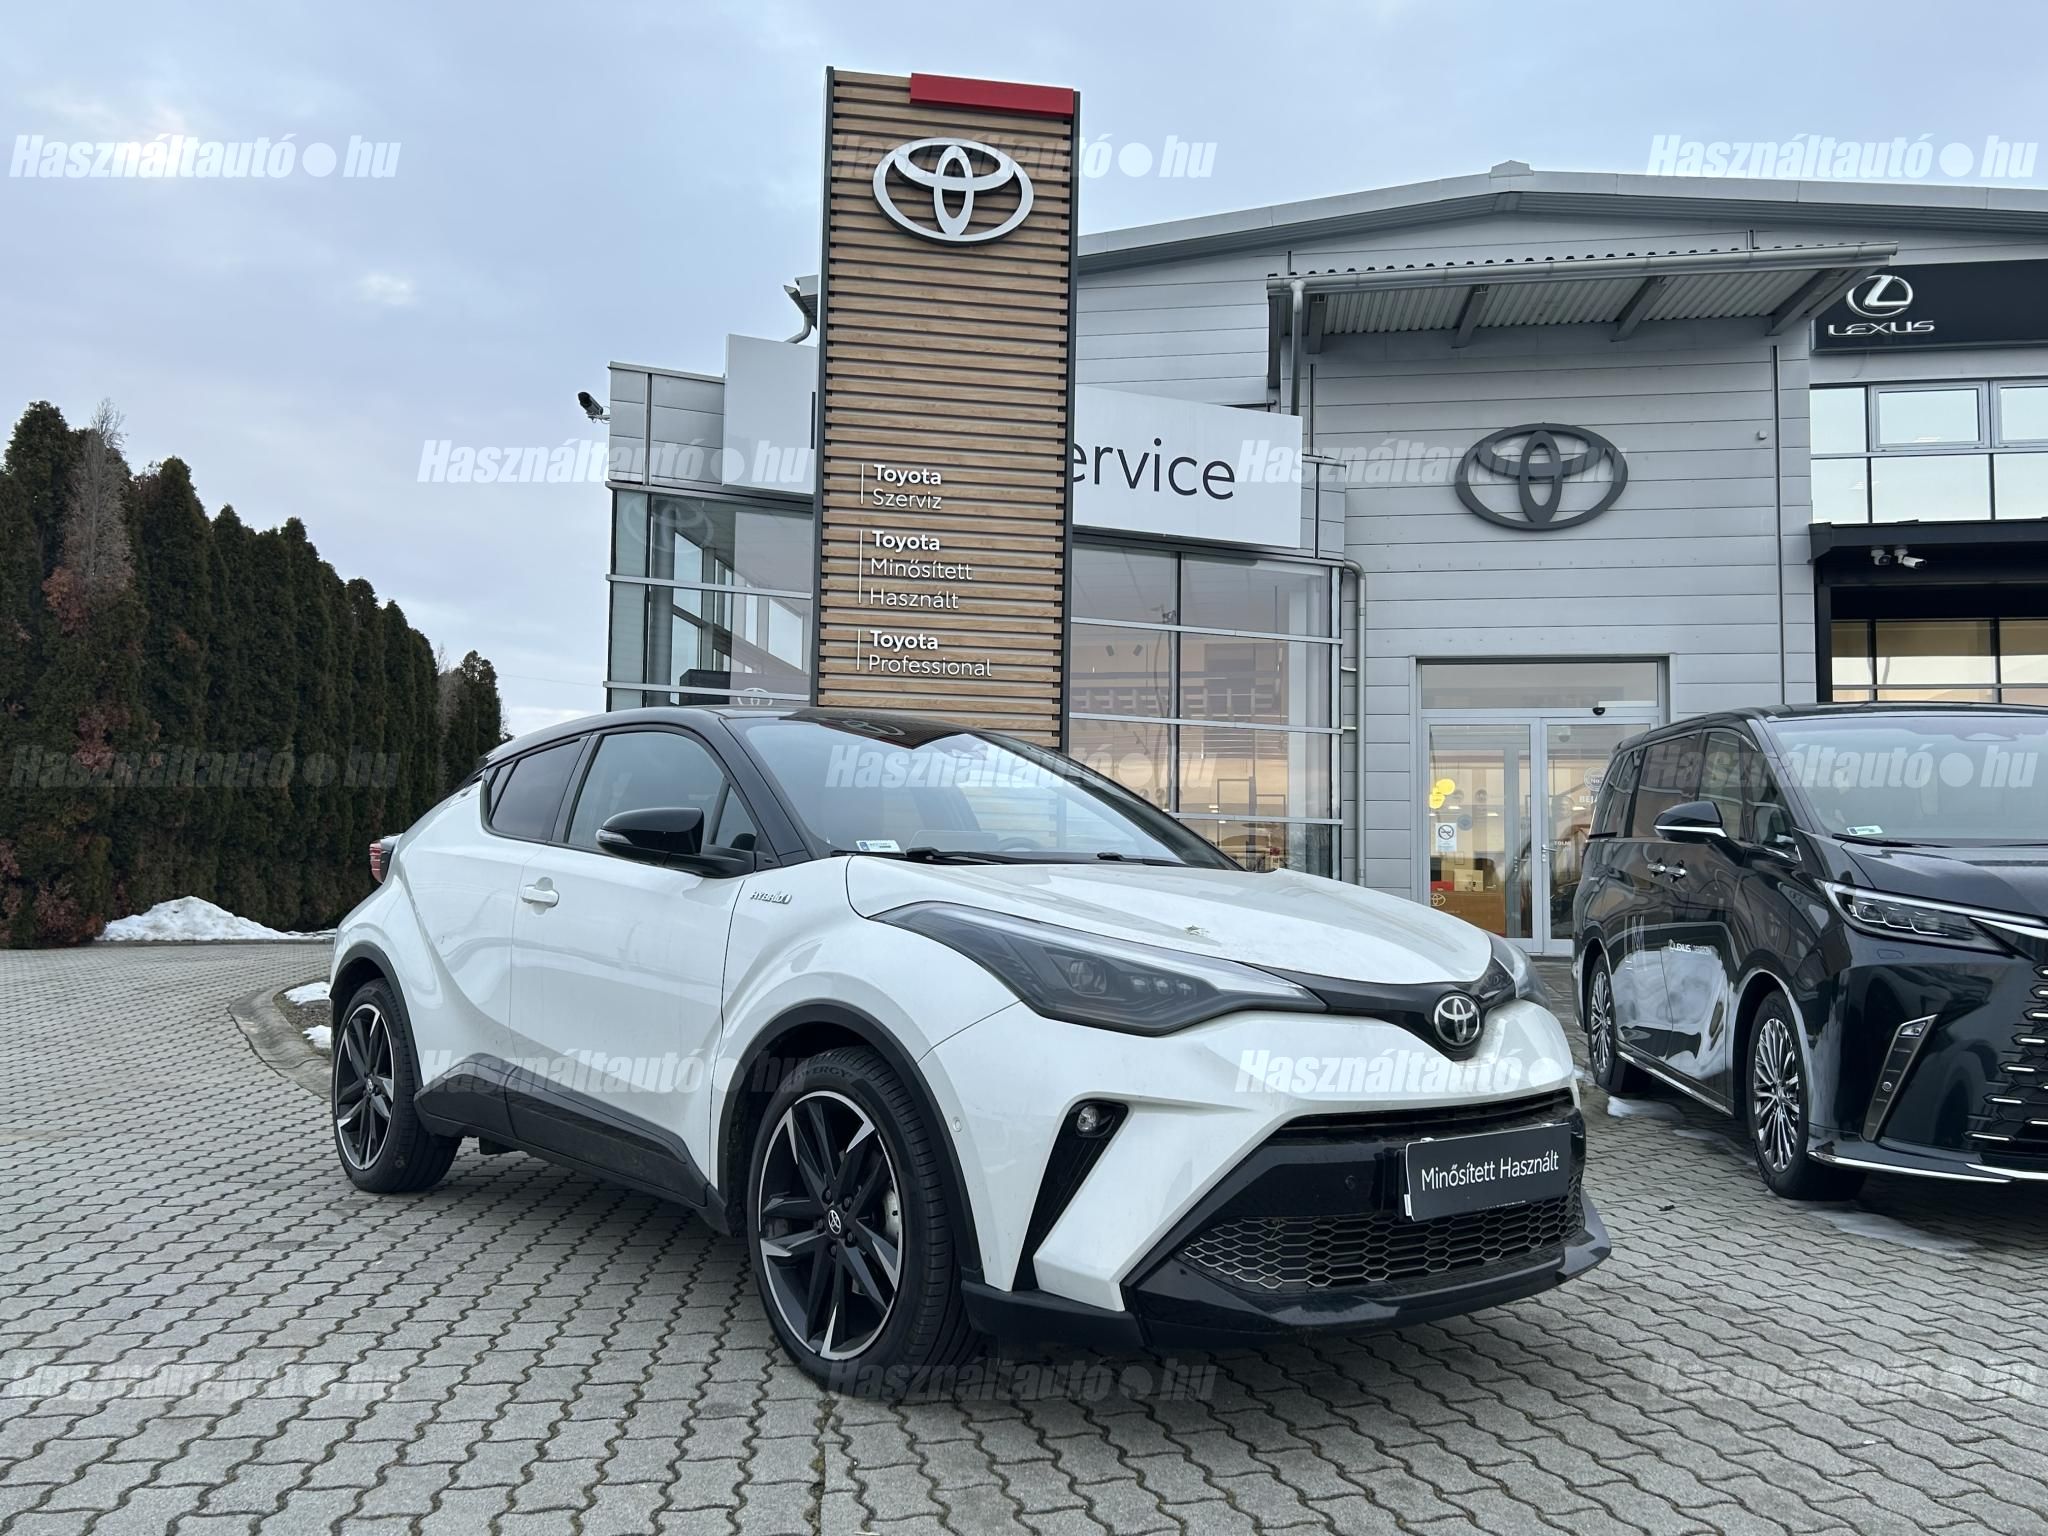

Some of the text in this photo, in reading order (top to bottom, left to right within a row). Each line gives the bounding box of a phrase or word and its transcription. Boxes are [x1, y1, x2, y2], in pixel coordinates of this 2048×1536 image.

[1828, 320, 1935, 336] LEXUS
[873, 464, 942, 487] Toyota
[872, 488, 942, 510] Szerviz
[871, 530, 940, 553] Toyota
[870, 557, 973, 580] Minősített
[869, 587, 959, 609] Használt
[869, 630, 939, 652] Toyota
[869, 654, 992, 677] Professional
[1421, 1150, 1559, 1192] Minősített Használt
